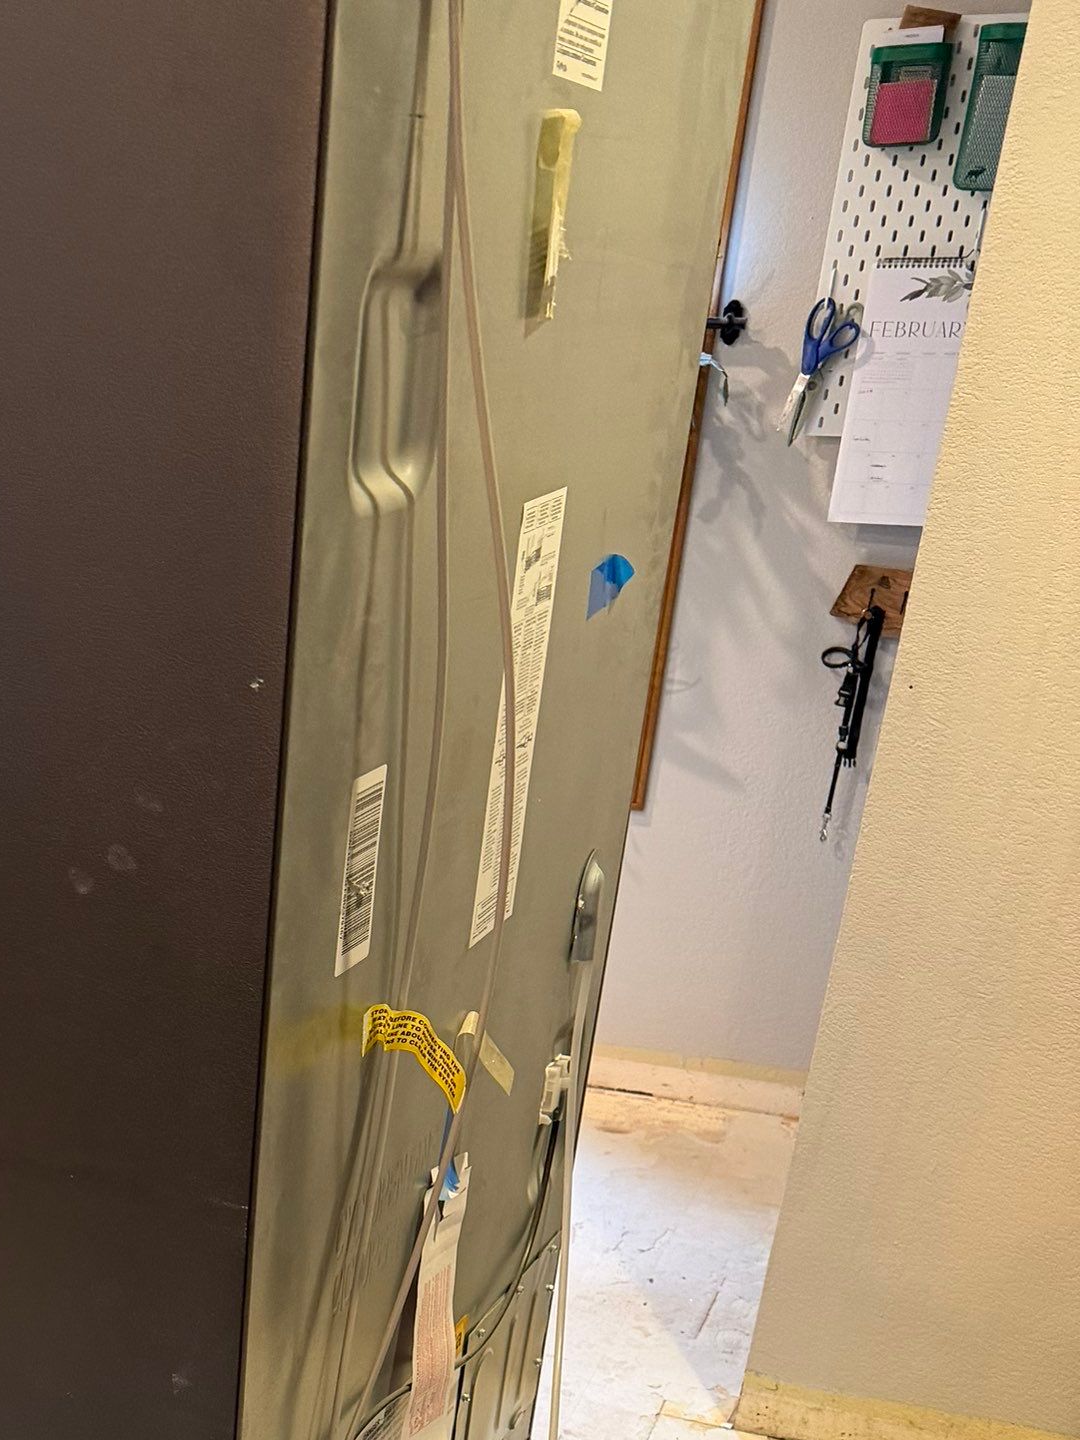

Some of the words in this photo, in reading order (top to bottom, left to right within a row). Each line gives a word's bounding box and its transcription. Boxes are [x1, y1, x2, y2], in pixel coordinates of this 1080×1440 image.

[869, 321, 967, 338] FEBRUAR
[410, 1024, 421, 1032] TO
[389, 1015, 417, 1023] BEFORE
[451, 1060, 460, 1075] THE
[400, 1031, 424, 1045] ABOUT
[427, 1059, 438, 1073] THE
